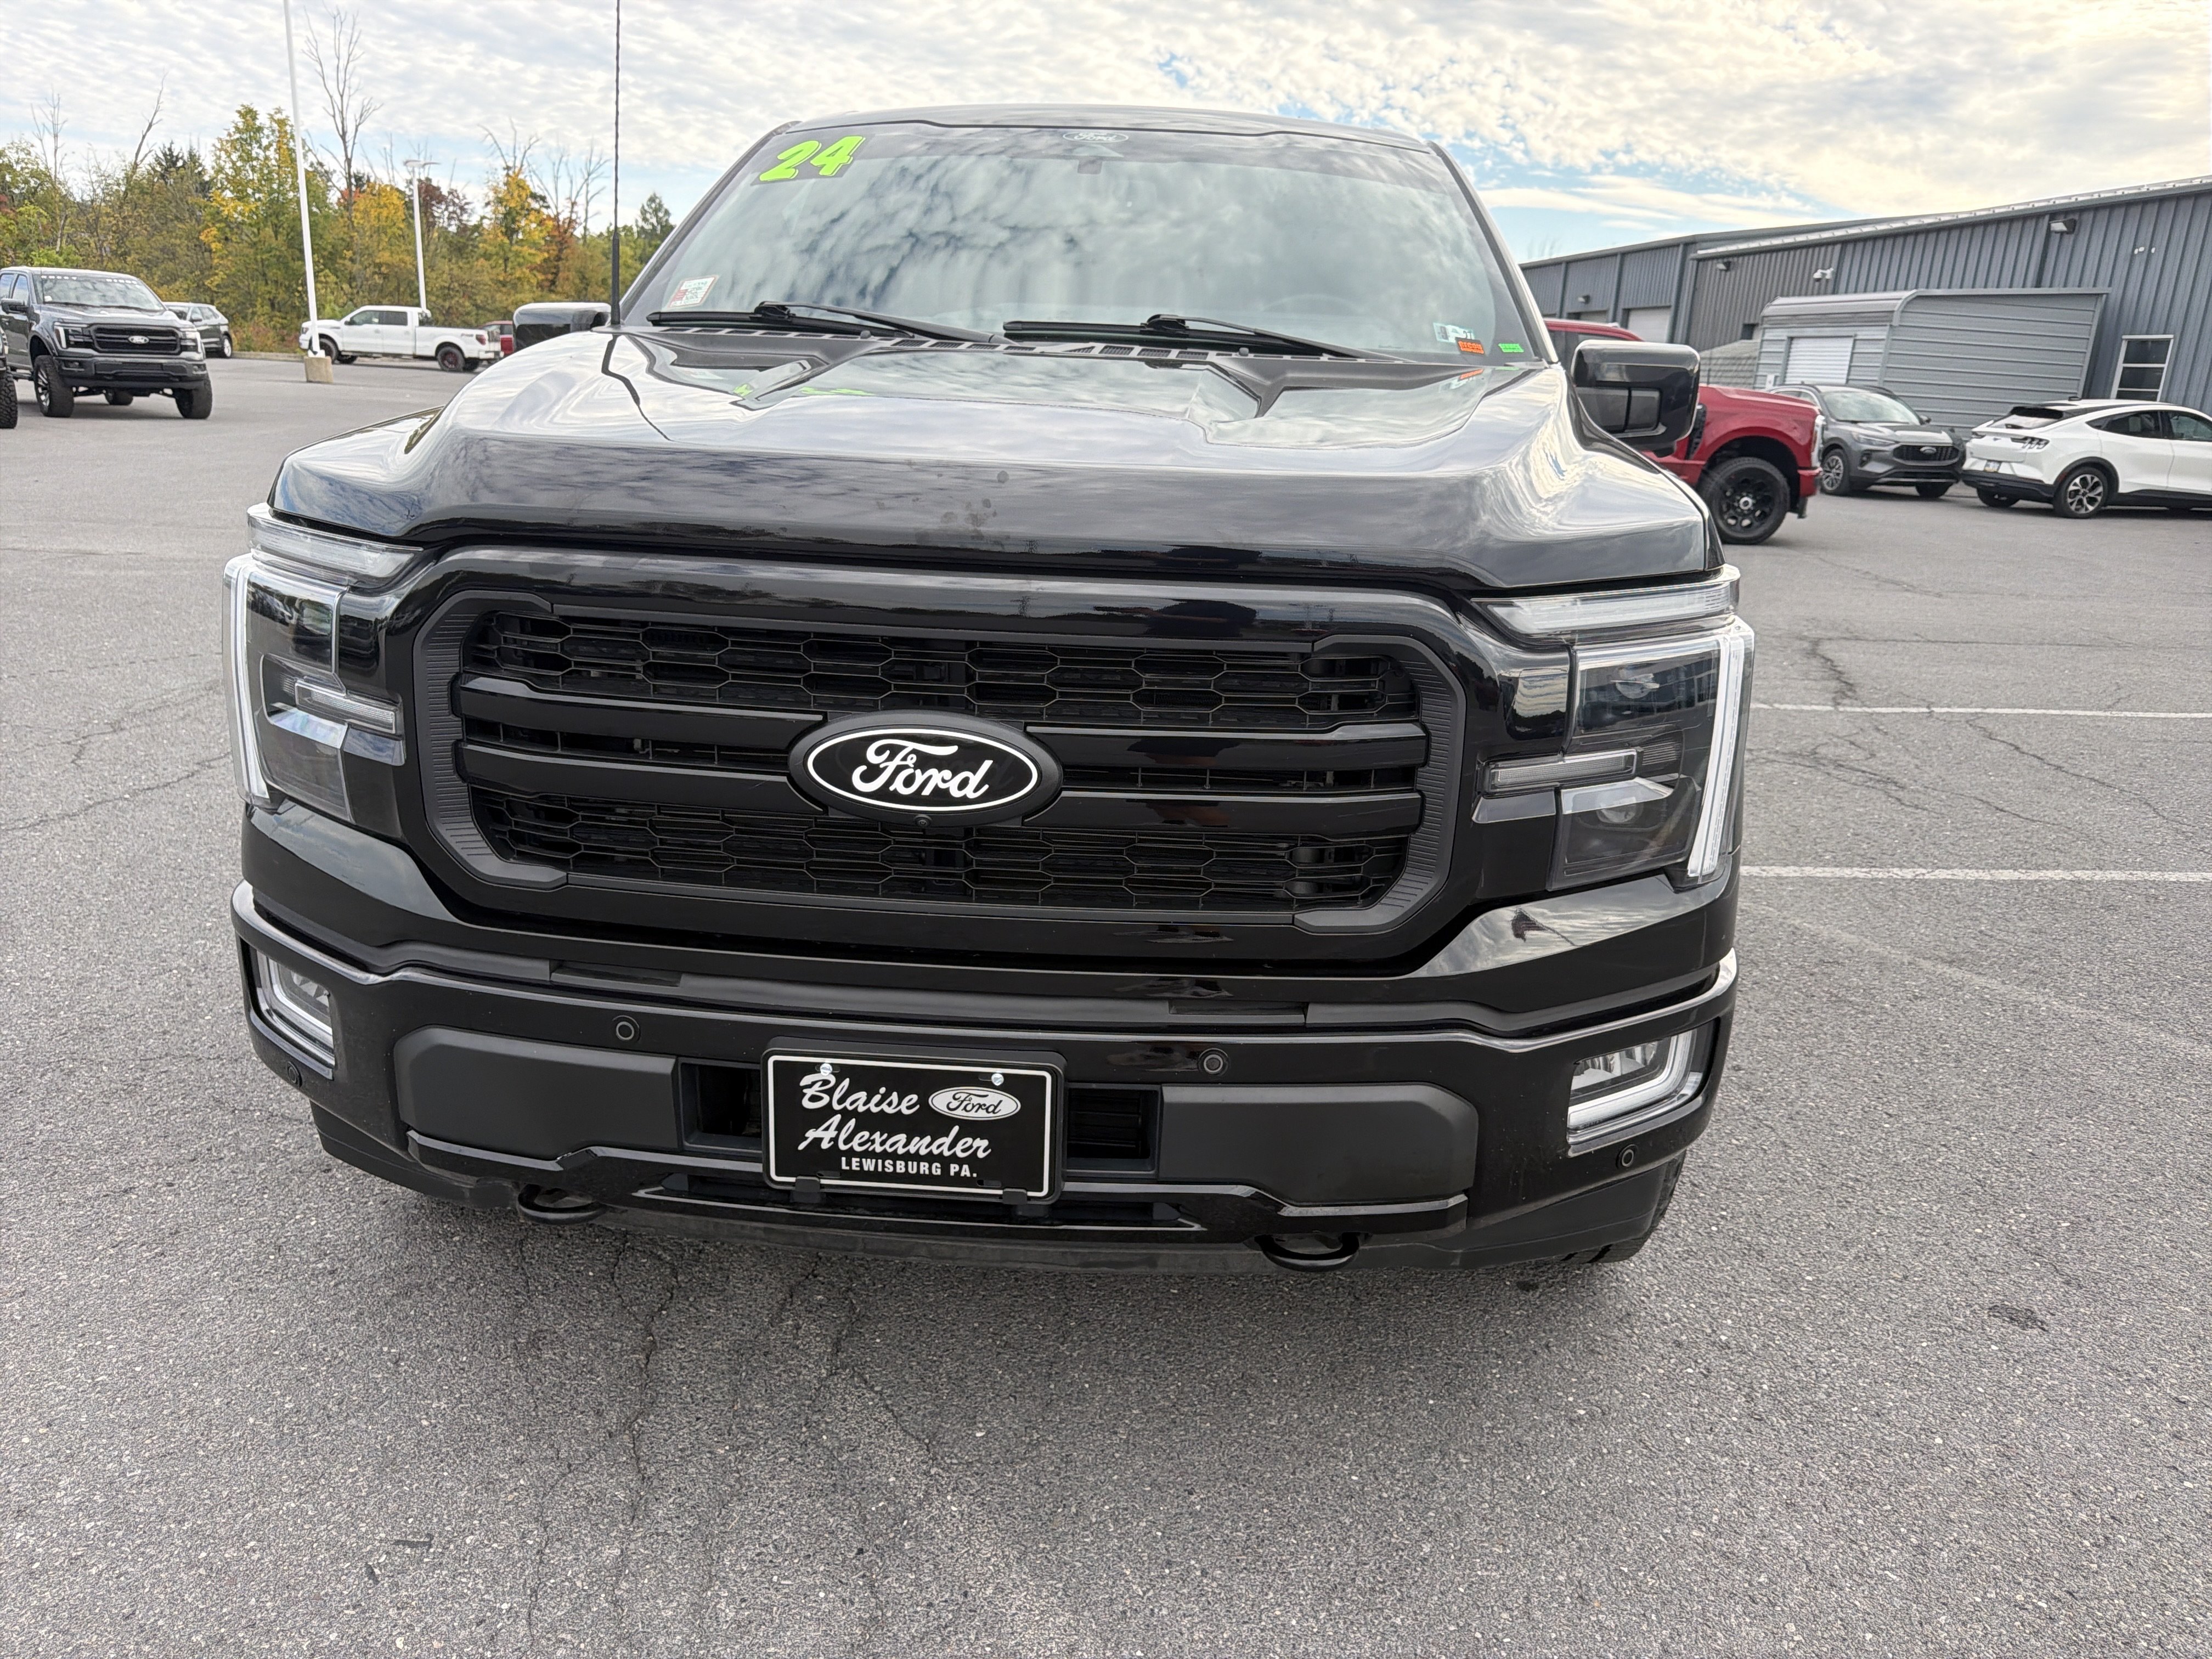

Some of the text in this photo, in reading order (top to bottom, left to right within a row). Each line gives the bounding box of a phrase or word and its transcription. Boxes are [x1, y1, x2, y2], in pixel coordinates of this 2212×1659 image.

[1074, 132, 1117, 141] Ford
[759, 136, 866, 181] 24
[852, 739, 993, 798] Ford
[799, 1073, 920, 1115] Blaise
[946, 1092, 1003, 1114] Ford
[798, 1114, 991, 1158] Alexander
[842, 1157, 977, 1177] LEWISBURG PA.
